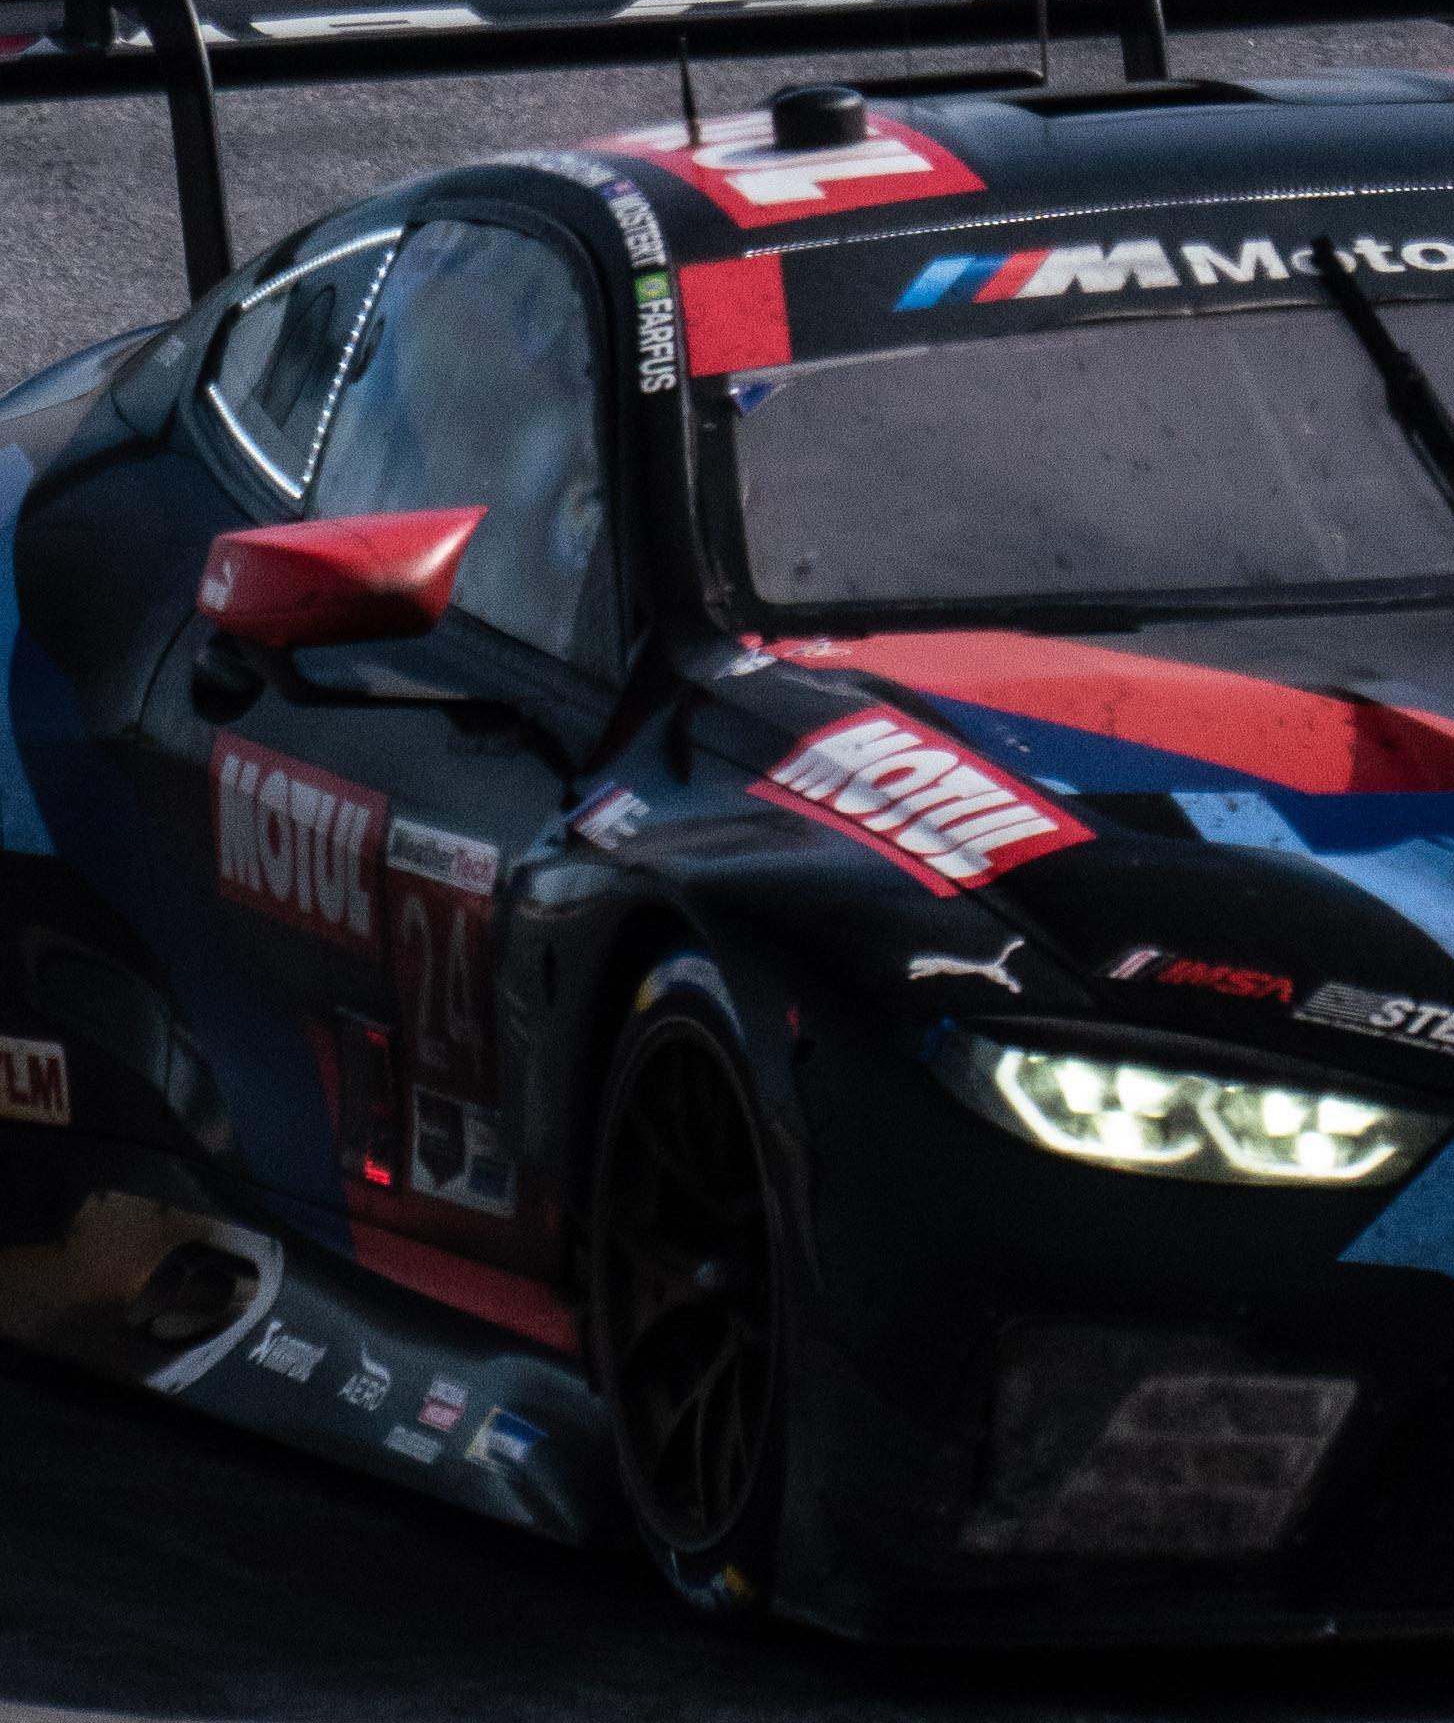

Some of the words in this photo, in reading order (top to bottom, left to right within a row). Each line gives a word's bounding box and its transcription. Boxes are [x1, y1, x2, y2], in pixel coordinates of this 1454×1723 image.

[636, 298, 678, 396] FARFUS
[218, 752, 372, 938] MOTUL
[769, 718, 1060, 880] MOTUL
